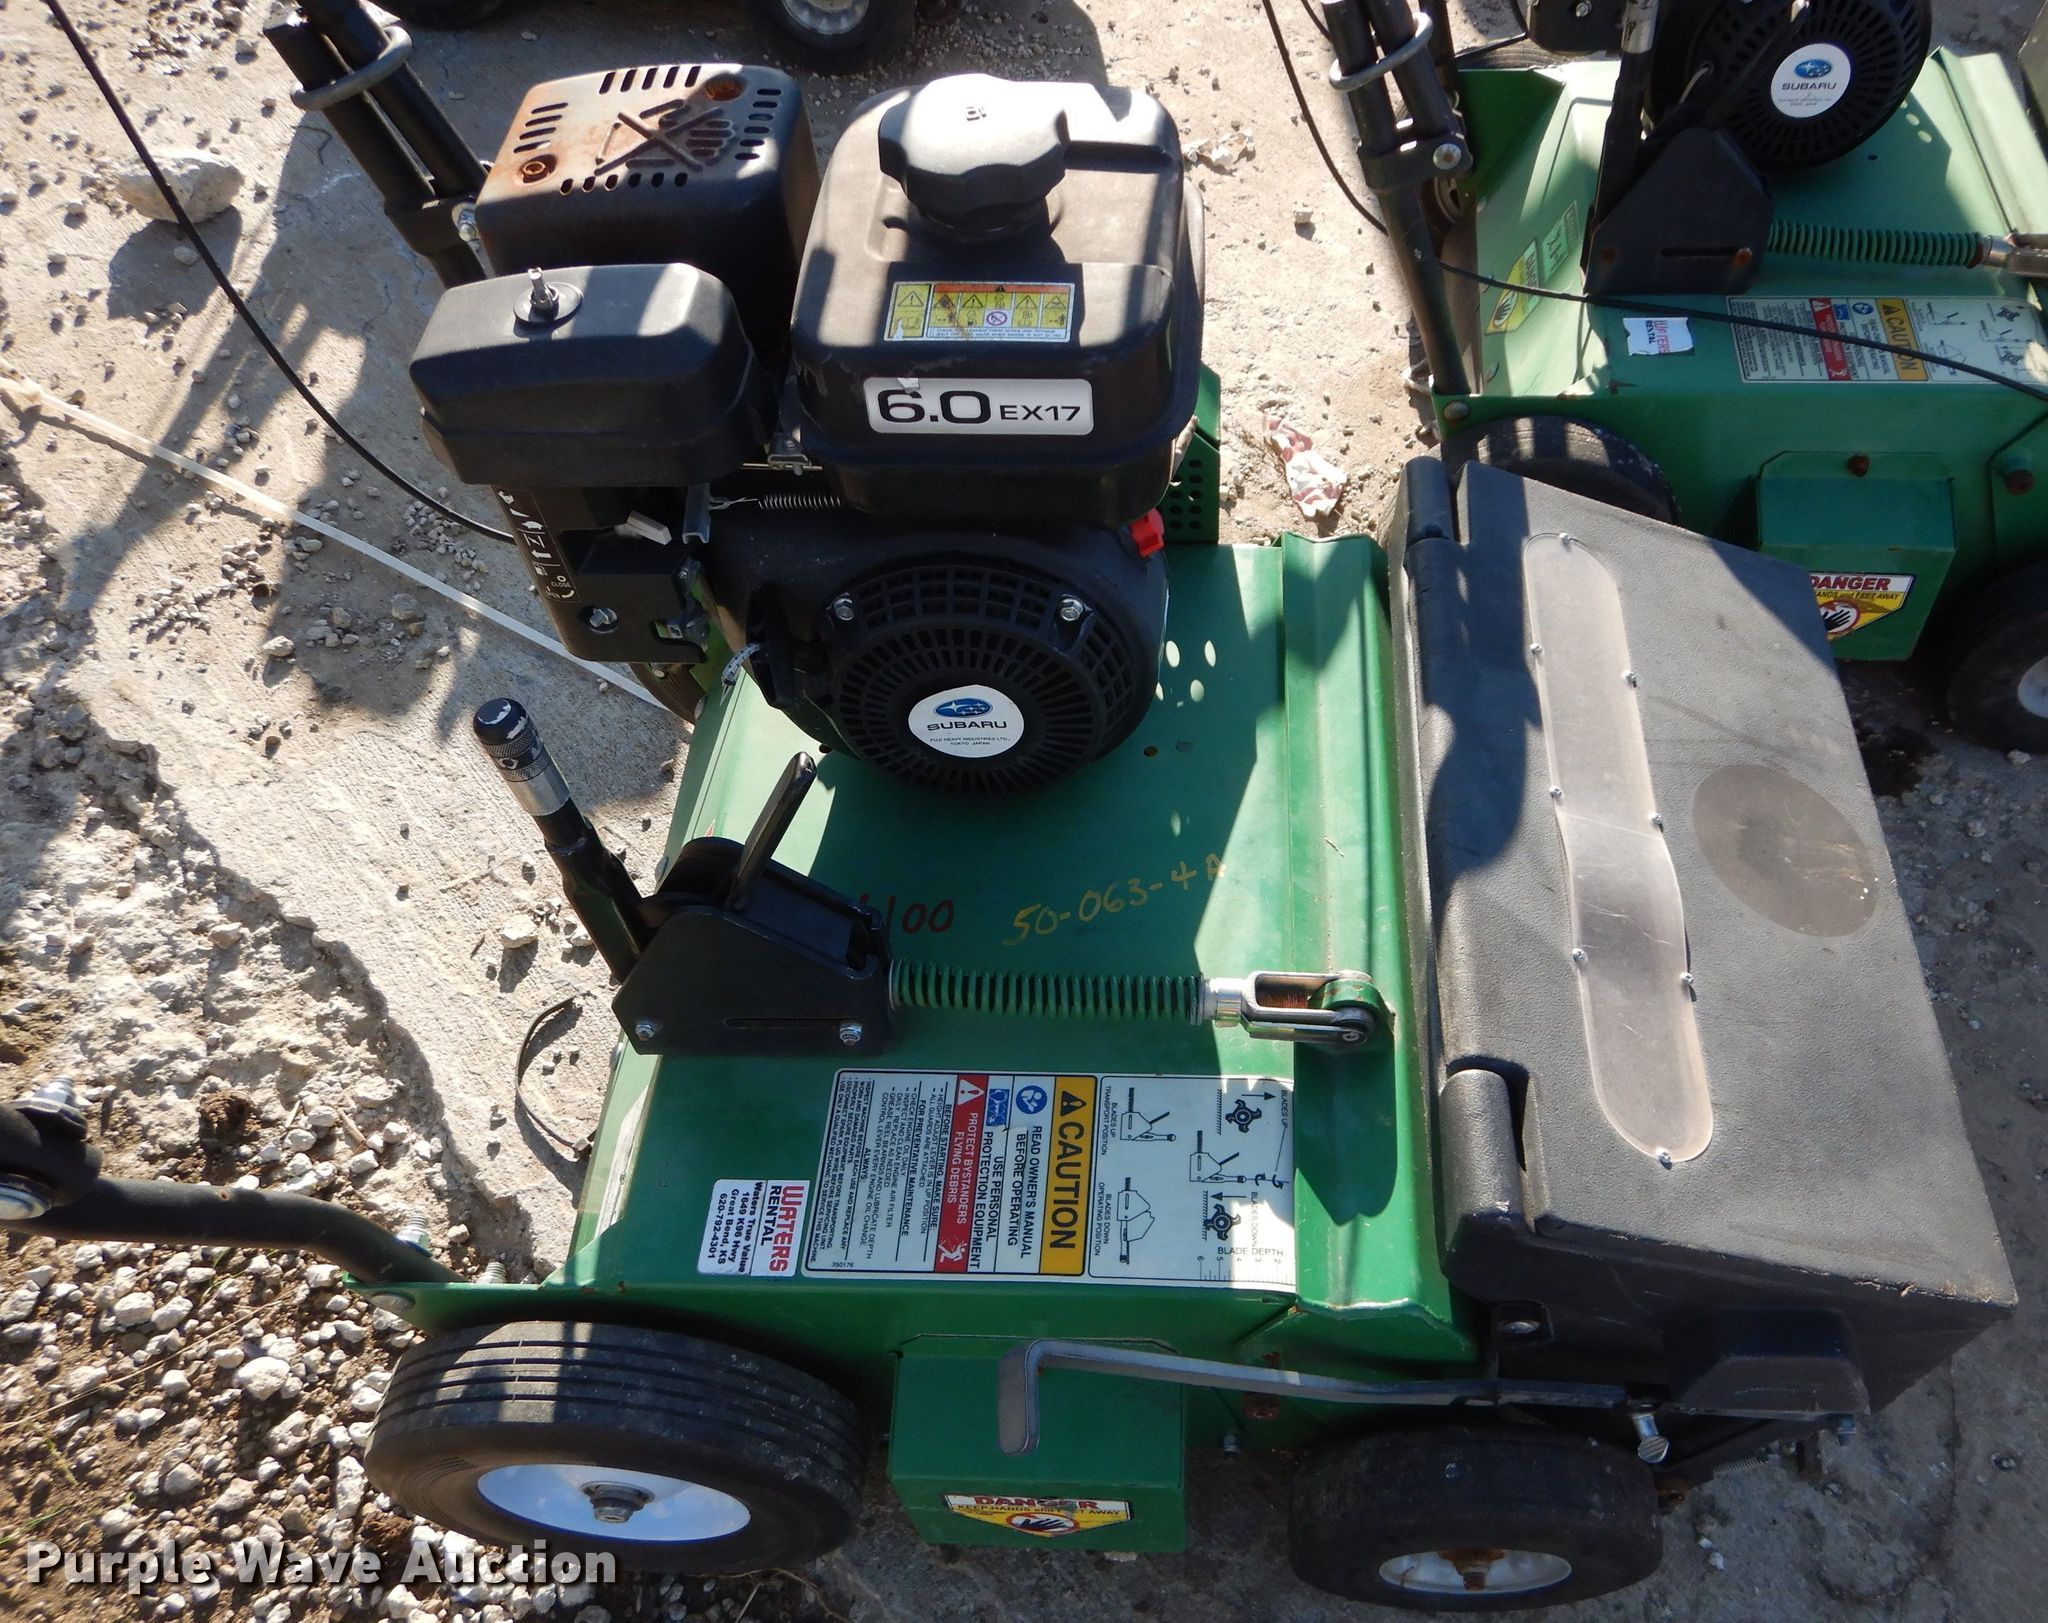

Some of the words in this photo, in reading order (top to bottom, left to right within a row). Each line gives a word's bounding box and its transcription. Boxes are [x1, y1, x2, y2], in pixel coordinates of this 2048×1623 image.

[1781, 82, 1837, 91] SUBARU
[1645, 320, 1656, 344] RENTAL
[877, 388, 991, 424] 6.0
[1000, 405, 1081, 421] EX17
[927, 721, 1007, 731] SUBARU
[877, 1092, 889, 1123] CONTROL
[900, 1092, 910, 1120] INSPECT
[907, 1092, 917, 1115] CHECK
[917, 1099, 927, 1115] FOR
[929, 1093, 937, 1105] ALL
[934, 1094, 944, 1118] HEIGHT
[1102, 1085, 1111, 1123] TRANSPORT
[1280, 1089, 1288, 1116] BLADES
[925, 1106, 935, 1135] GUARDS
[941, 1103, 952, 1134] BEFORE
[1109, 1102, 1117, 1127] BLADES
[1280, 1117, 1288, 1128] UP
[874, 1125, 884, 1148] LEVER
[897, 1121, 906, 1136] AND
[904, 1117, 914, 1142] ENGINE
[930, 1119, 940, 1145] ADJUST
[964, 1112, 978, 1157] PROTECT
[1029, 1125, 1043, 1155] READ
[1100, 1125, 1108, 1155] POSITION
[1109, 1128, 1116, 1137] UP
[894, 1137, 904, 1161] CLEAN
[902, 1144, 910, 1155] OIL
[908, 1117, 924, 1175] PREVENTATIVE
[923, 1136, 931, 1149] ARE
[951, 1131, 964, 1164] FLYING
[1012, 1133, 1027, 1177] BEFORE
[859, 1147, 871, 1183] ALWAYS:
[870, 1149, 880, 1171] EVERY
[899, 1157, 908, 1176] DAILY
[917, 1151, 929, 1187] ATTACHED
[927, 1147, 937, 1169] LEVER
[935, 1136, 948, 1178] STARTING,
[975, 1131, 994, 1201] PROTECTION
[991, 1155, 1004, 1177] USE
[865, 1173, 876, 1200] ENGINE
[890, 1162, 900, 1188] ENGINE
[946, 1167, 960, 1204] DEBRIS
[1024, 1157, 1040, 1208] OWNER'S
[1049, 1121, 1085, 1249] CAUTION
[726, 1188, 740, 1216] Great
[748, 1181, 763, 1215] Waters
[888, 1189, 896, 1202] AIR
[923, 1187, 932, 1198] UP
[932, 1180, 943, 1204] MAKE
[956, 1158, 973, 1224] BYSTANDERS
[1095, 1181, 1104, 1216] OPERATING
[760, 1185, 782, 1246] RENTAL
[863, 1201, 872, 1213] OIL
[884, 1203, 894, 1228] FILTER
[900, 1176, 916, 1236] MAINTENANCE
[919, 1199, 930, 1234] POSITION
[928, 1205, 939, 1231] SURE:
[984, 1180, 1001, 1242] PERSONAL
[1005, 1179, 1023, 1246] OPERATING
[1103, 1193, 1112, 1220] BLADES
[1250, 1191, 1258, 1221] BLADES
[705, 1192, 729, 1259] 620-792-4301
[719, 1218, 733, 1247] Bend,
[743, 1218, 756, 1241] True
[768, 1185, 804, 1272] WATERS
[968, 1203, 986, 1268] EQUIPMENT
[1020, 1211, 1035, 1258] MANUAL
[1093, 1217, 1102, 1256] POSITION
[1102, 1221, 1110, 1244] DOWN
[716, 1249, 727, 1264] KS
[726, 1240, 740, 1262] Hwy
[737, 1243, 751, 1273] Value
[1218, 1246, 1248, 1256] BLADE
[1252, 1248, 1284, 1257] DEPTH
